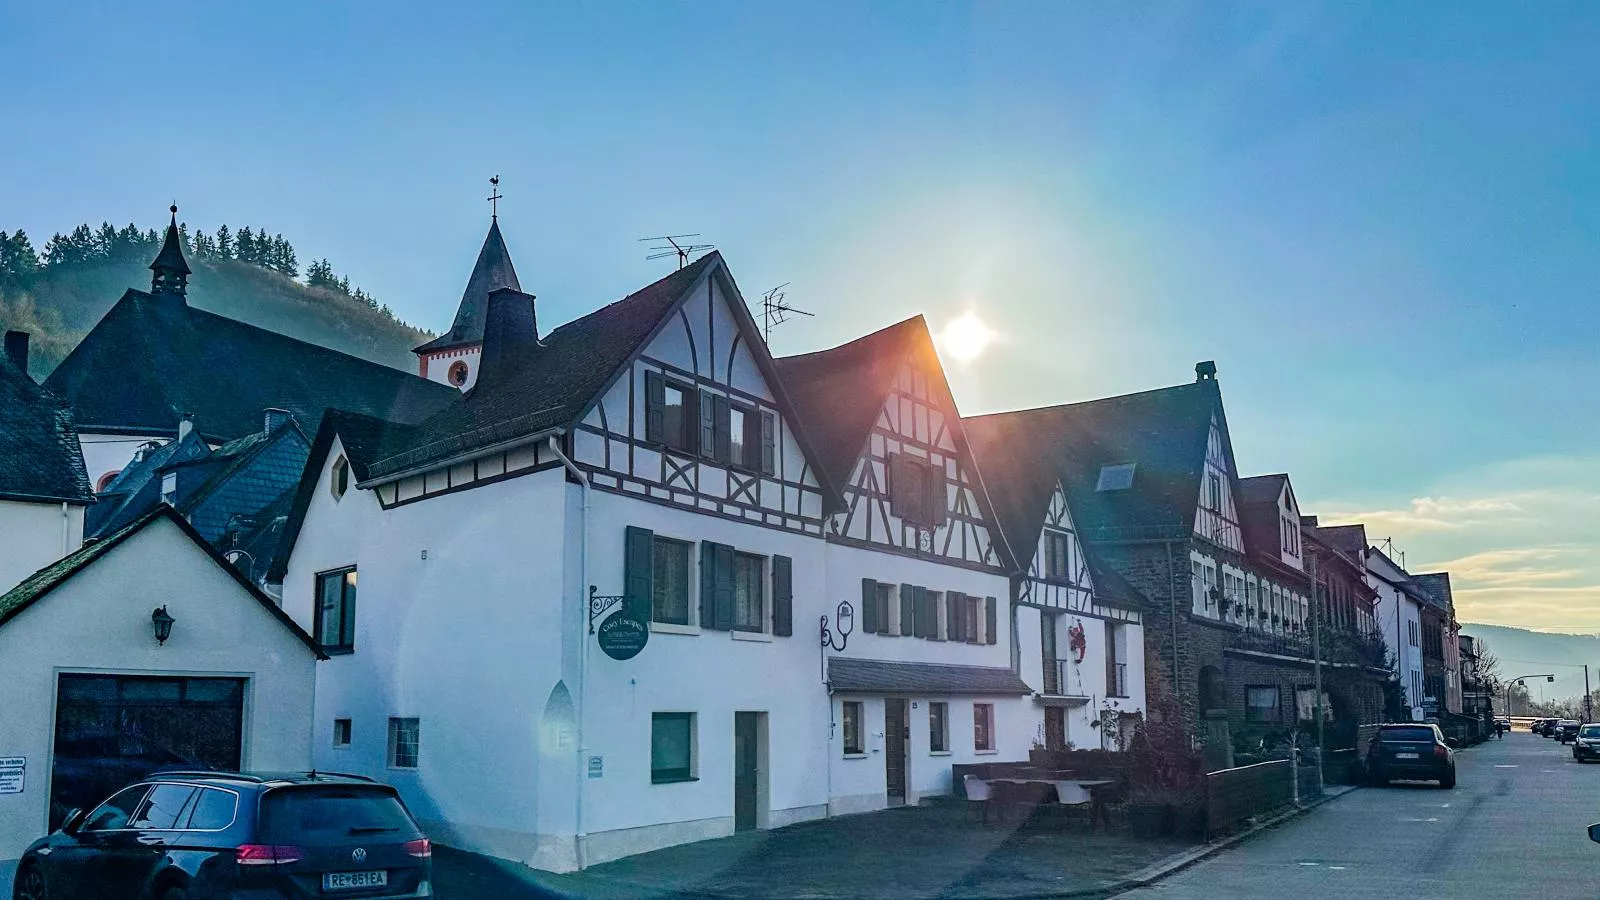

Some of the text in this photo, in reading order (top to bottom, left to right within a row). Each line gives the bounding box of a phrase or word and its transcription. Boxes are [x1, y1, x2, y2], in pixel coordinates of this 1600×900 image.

[602, 617, 644, 632] Cozy Escapes
[332, 873, 346, 887] RE
